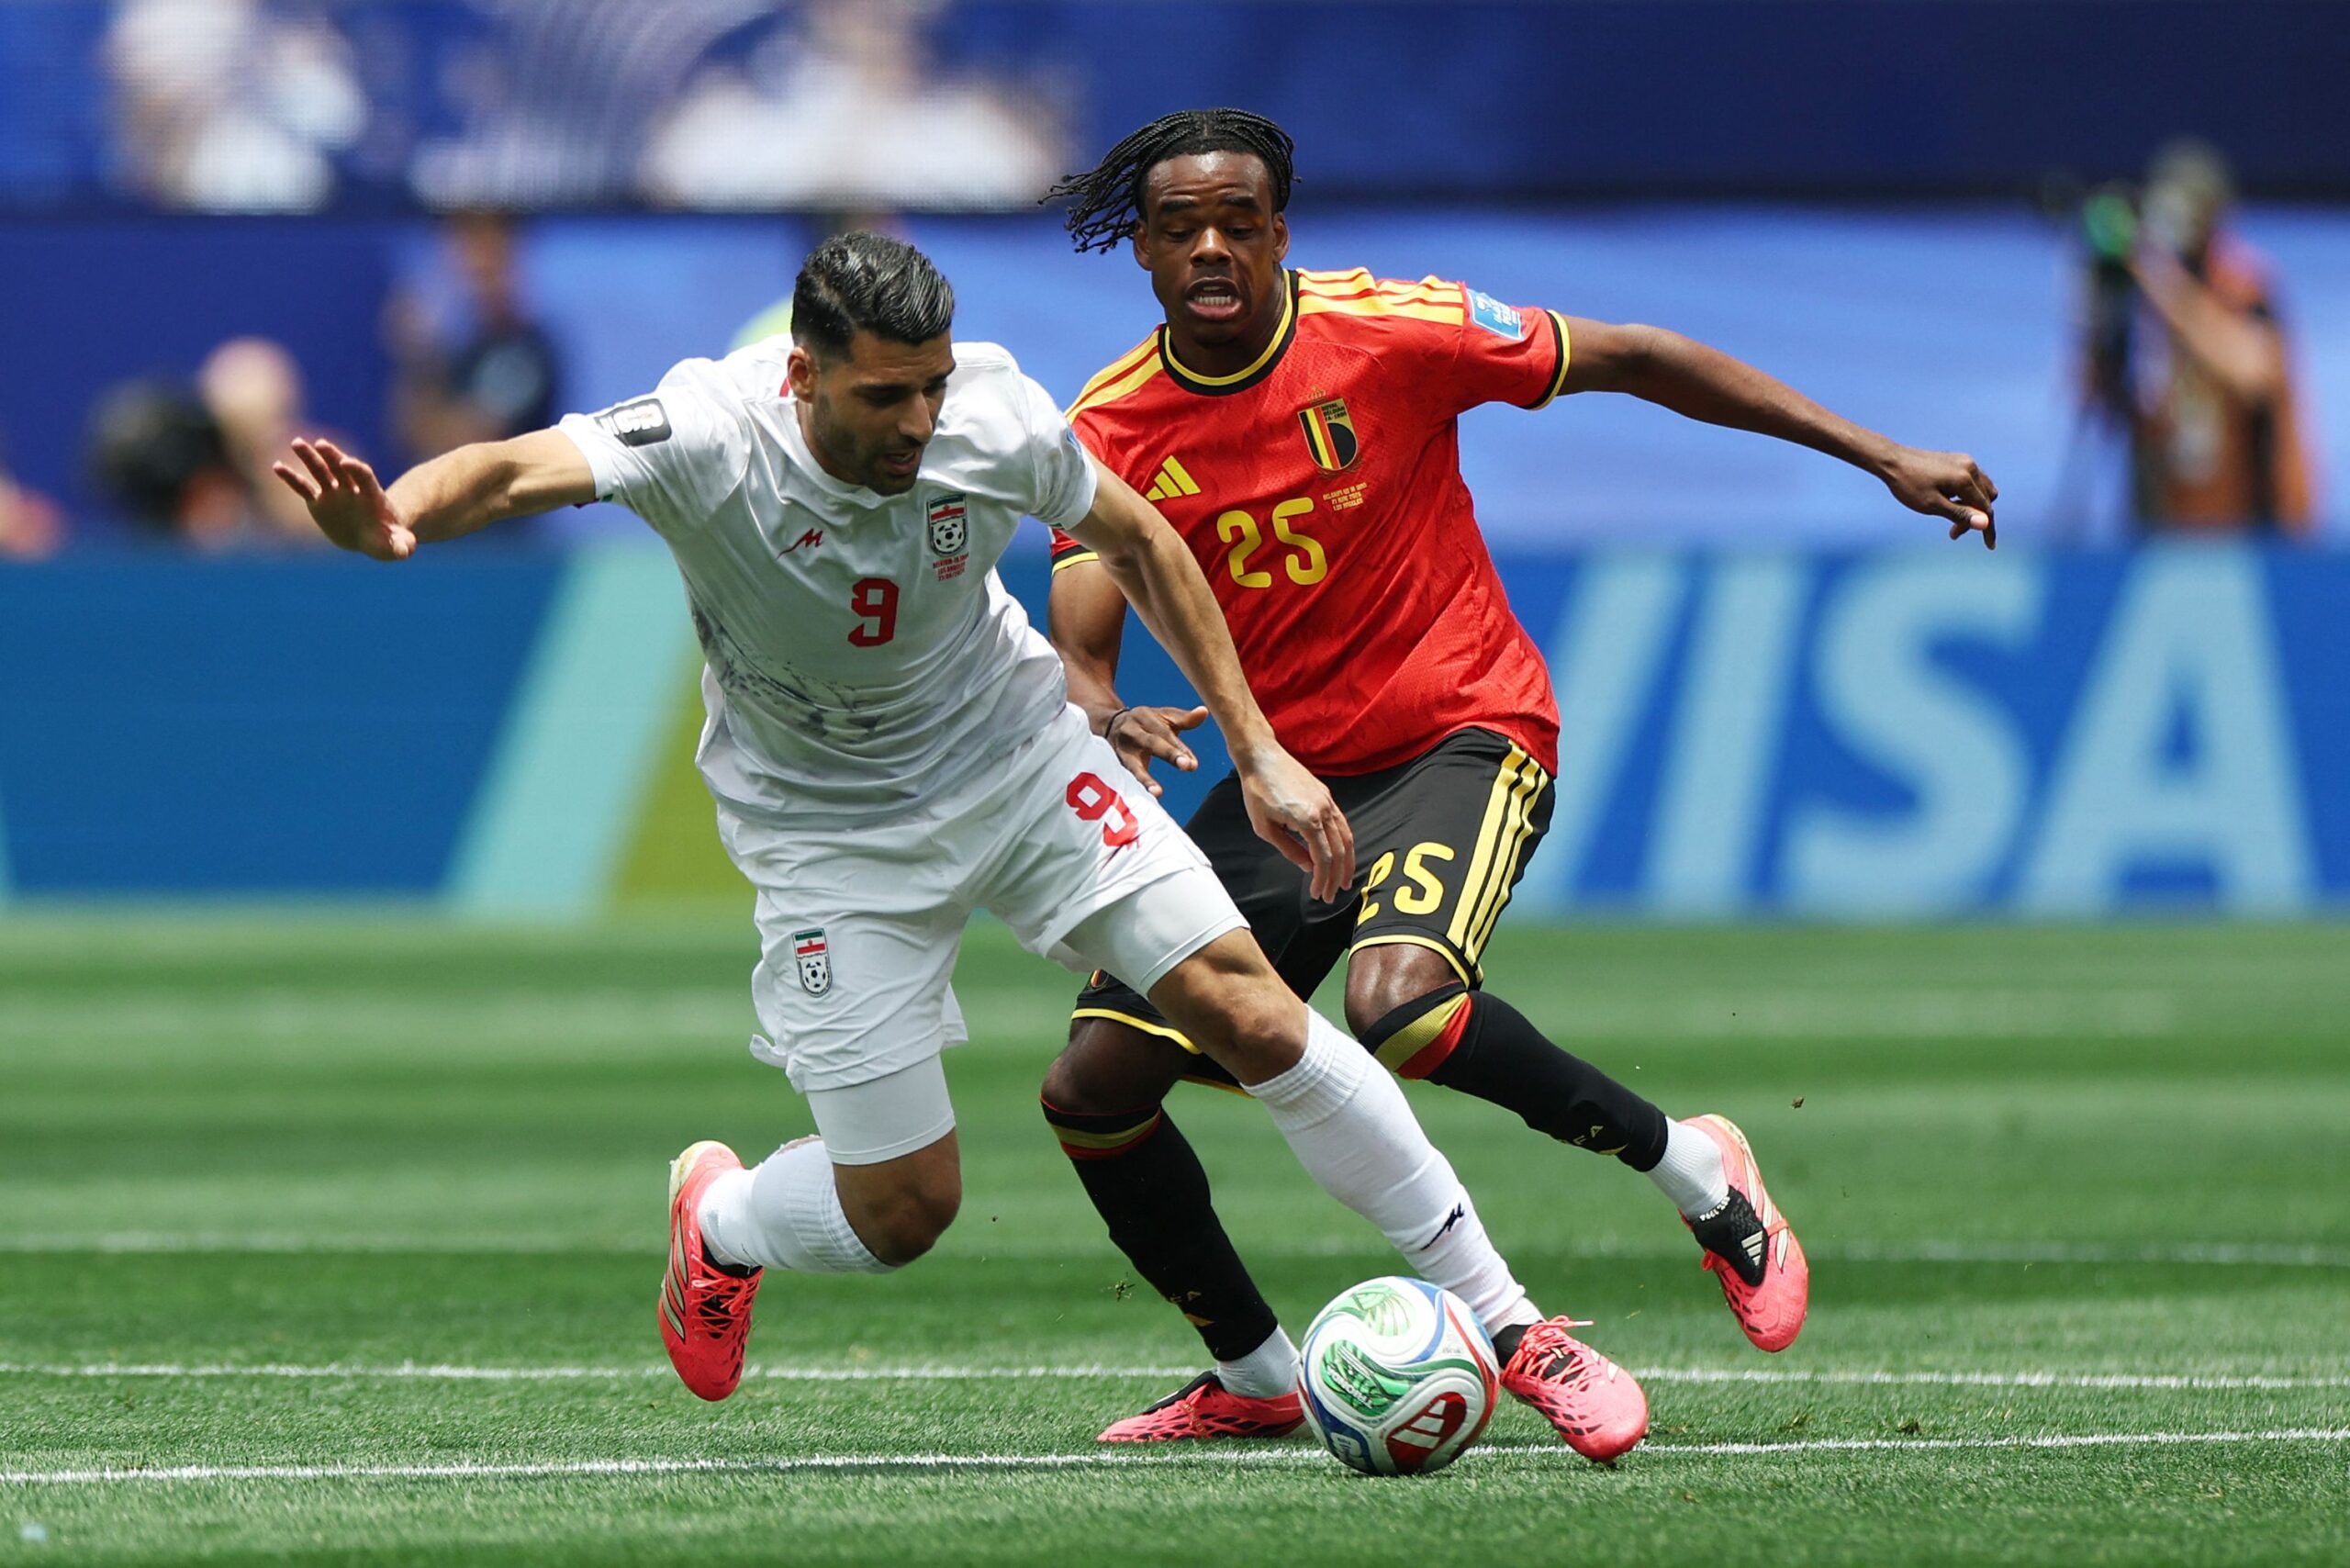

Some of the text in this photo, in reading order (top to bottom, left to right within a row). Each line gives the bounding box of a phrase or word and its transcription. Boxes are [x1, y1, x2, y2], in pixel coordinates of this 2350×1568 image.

[1216, 497, 1328, 588] 25
[847, 578, 900, 647] 9
[1066, 772, 1140, 848] 9
[1357, 842, 1455, 926] 25
[1326, 1364, 1372, 1409] TRIONDA
